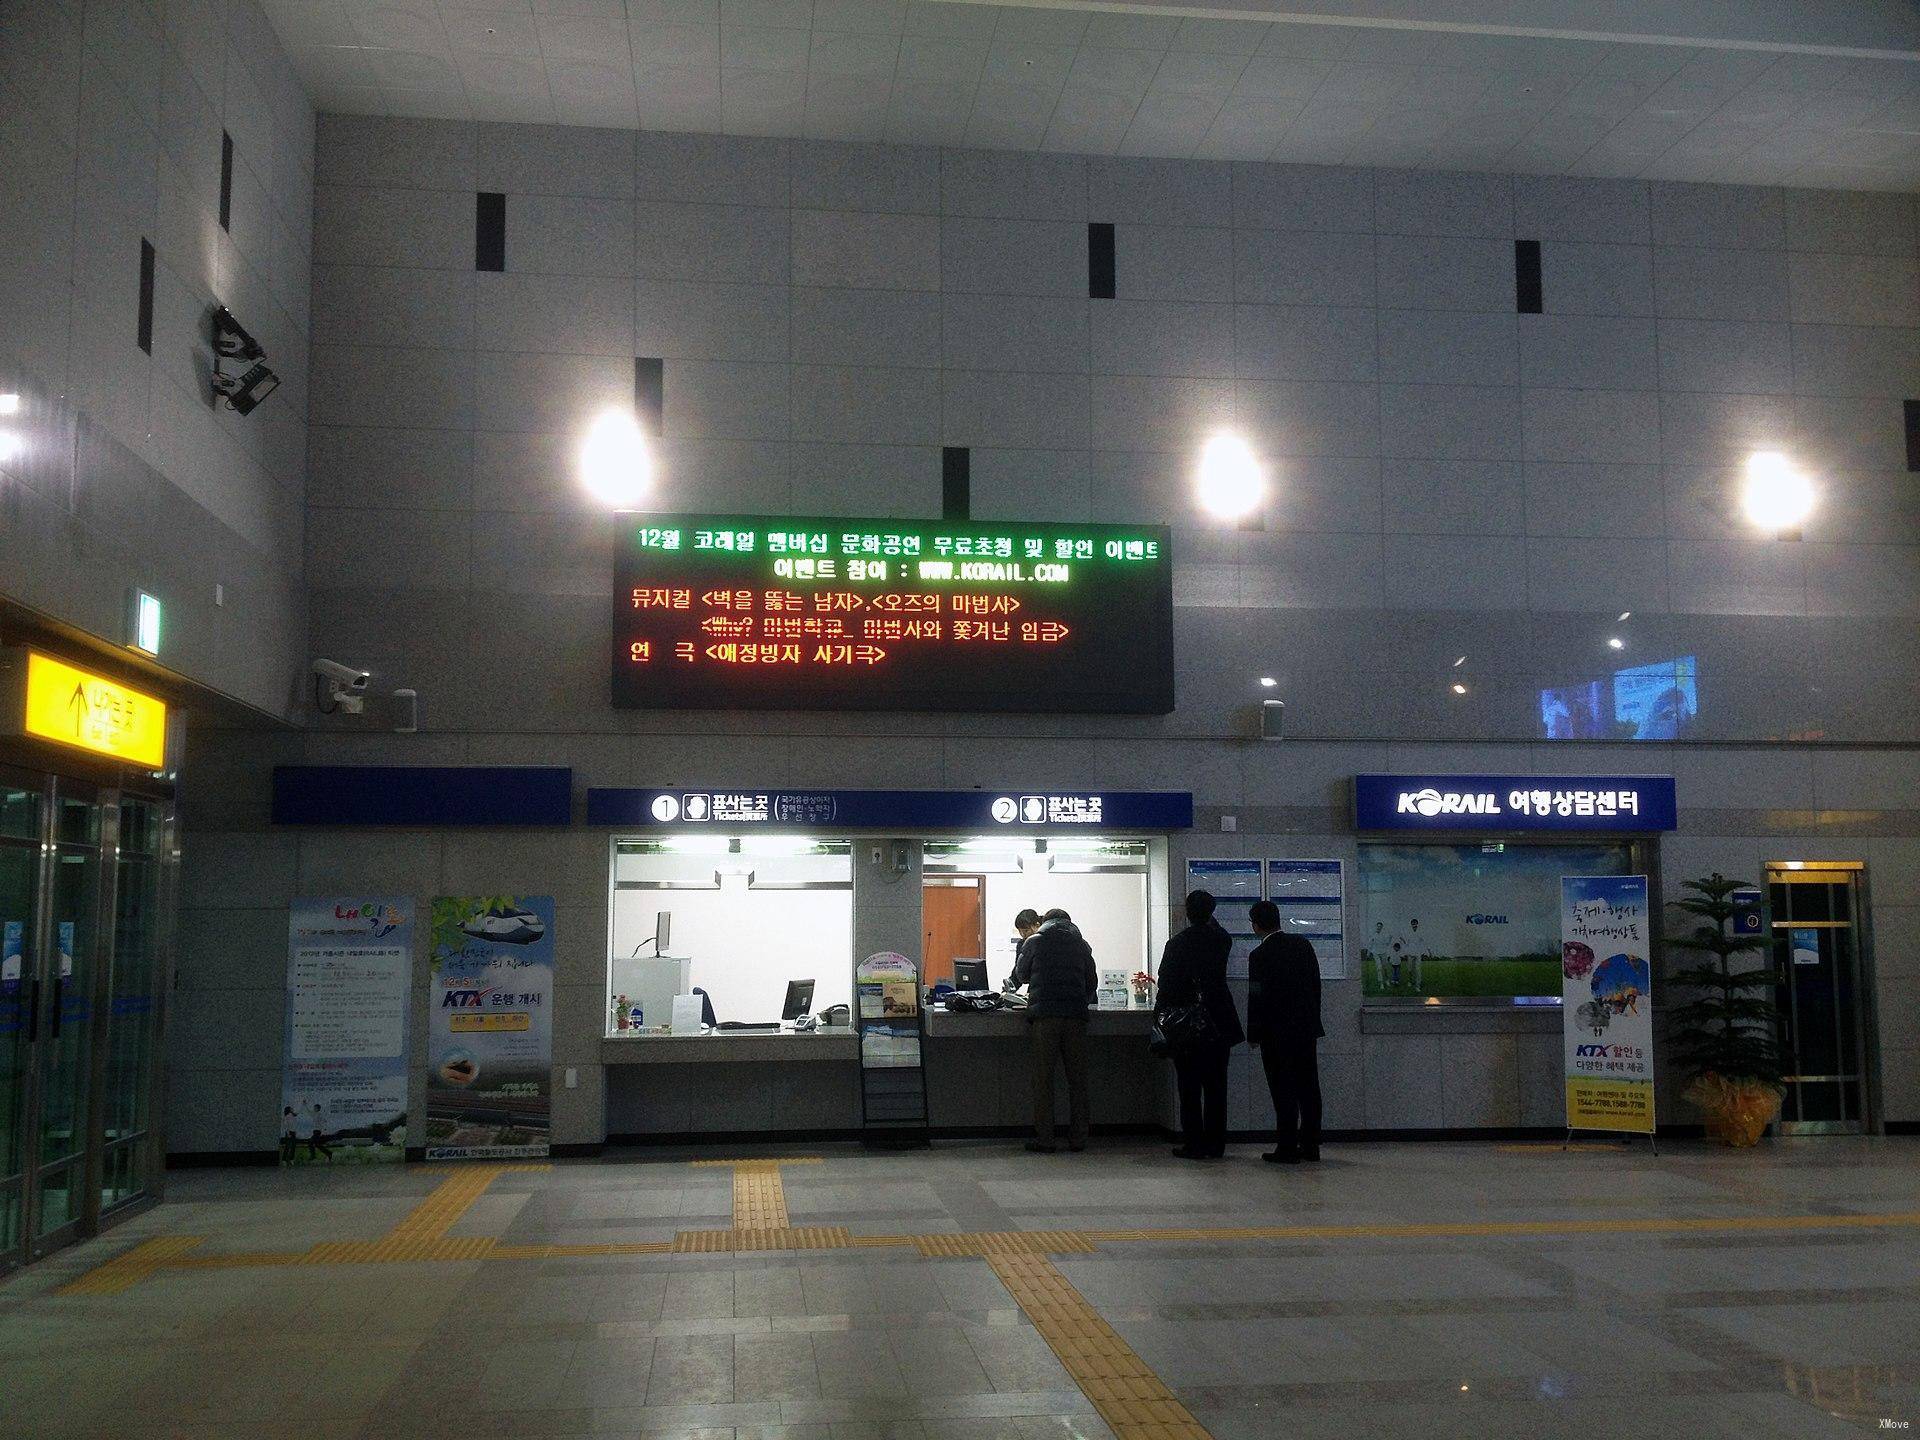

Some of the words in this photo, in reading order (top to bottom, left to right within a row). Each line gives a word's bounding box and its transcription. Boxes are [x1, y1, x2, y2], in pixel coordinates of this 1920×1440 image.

[638, 528, 681, 550] 12월
[693, 531, 755, 552] 코레일
[767, 532, 828, 553] 멤버십
[841, 534, 921, 555] 문화공연
[934, 536, 1012, 557] 무료초청
[1024, 538, 1043, 558] 및
[1055, 539, 1093, 559] 할인
[1105, 540, 1158, 560] 이벤트
[774, 559, 836, 579] 이벤트
[847, 559, 887, 581] 참여
[918, 560, 1069, 582] WWW.KORAIL.COM
[632, 589, 691, 609] 뮤지컬
[702, 590, 753, 610] <벽을
[764, 591, 803, 611] 뚫는
[952, 595, 1020, 615] 마법사>
[864, 619, 942, 640] 마법사와
[953, 621, 1010, 641] 쫓겨난
[1021, 622, 1069, 642] 임금>
[705, 643, 801, 664] <애정빙자
[813, 644, 886, 665] 사기극>
[755, 794, 768, 811] 곳
[1397, 789, 1501, 816] KORAIL
[1509, 790, 1638, 817] 여행상담센터
[1466, 913, 1508, 925] KORAIL
[442, 989, 484, 1008] KTX
[491, 994, 514, 1006] 운행
[518, 993, 542, 1005] 개시
[1576, 1044, 1613, 1058] KTX
[1576, 1061, 1604, 1071] 다양한
[1627, 1062, 1644, 1073] 제공
